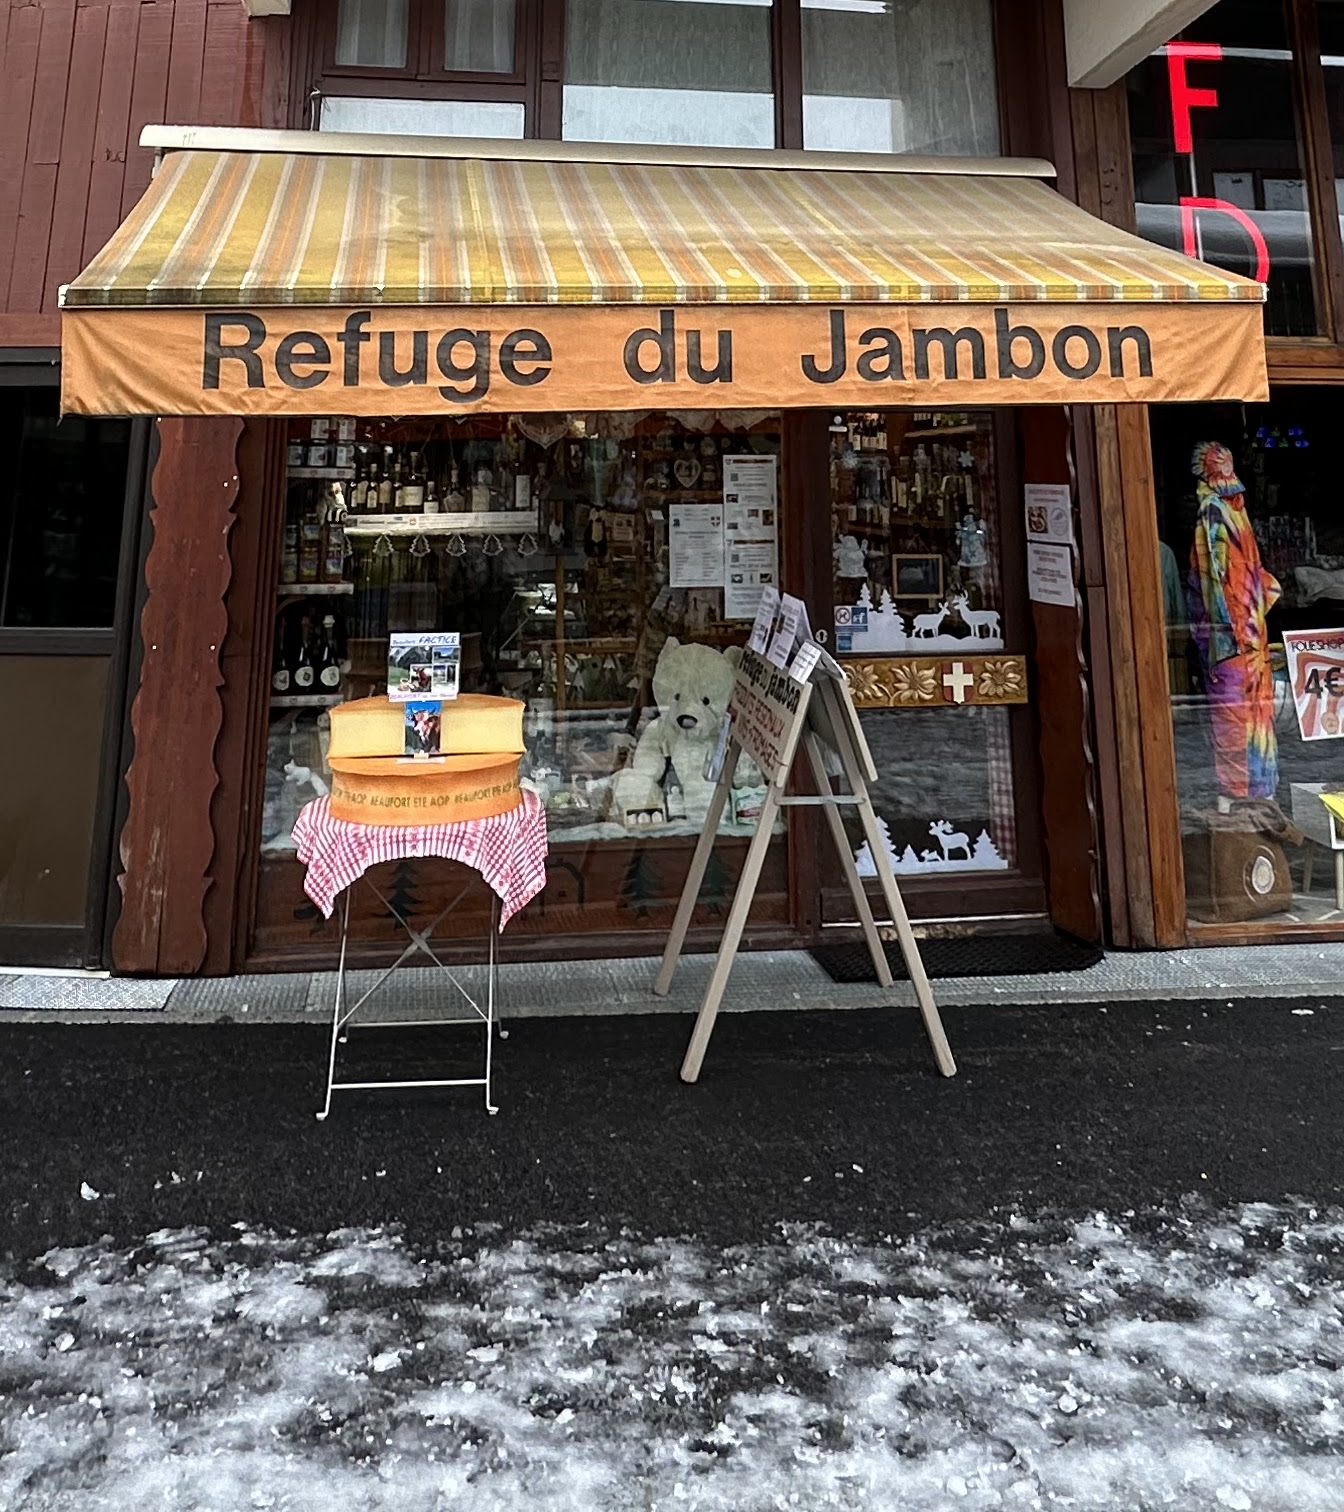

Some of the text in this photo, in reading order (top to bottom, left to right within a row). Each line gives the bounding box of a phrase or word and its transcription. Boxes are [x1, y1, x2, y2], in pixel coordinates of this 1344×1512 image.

[201, 308, 1154, 404] Refuge du Jambon
[430, 794, 450, 806] AOP
